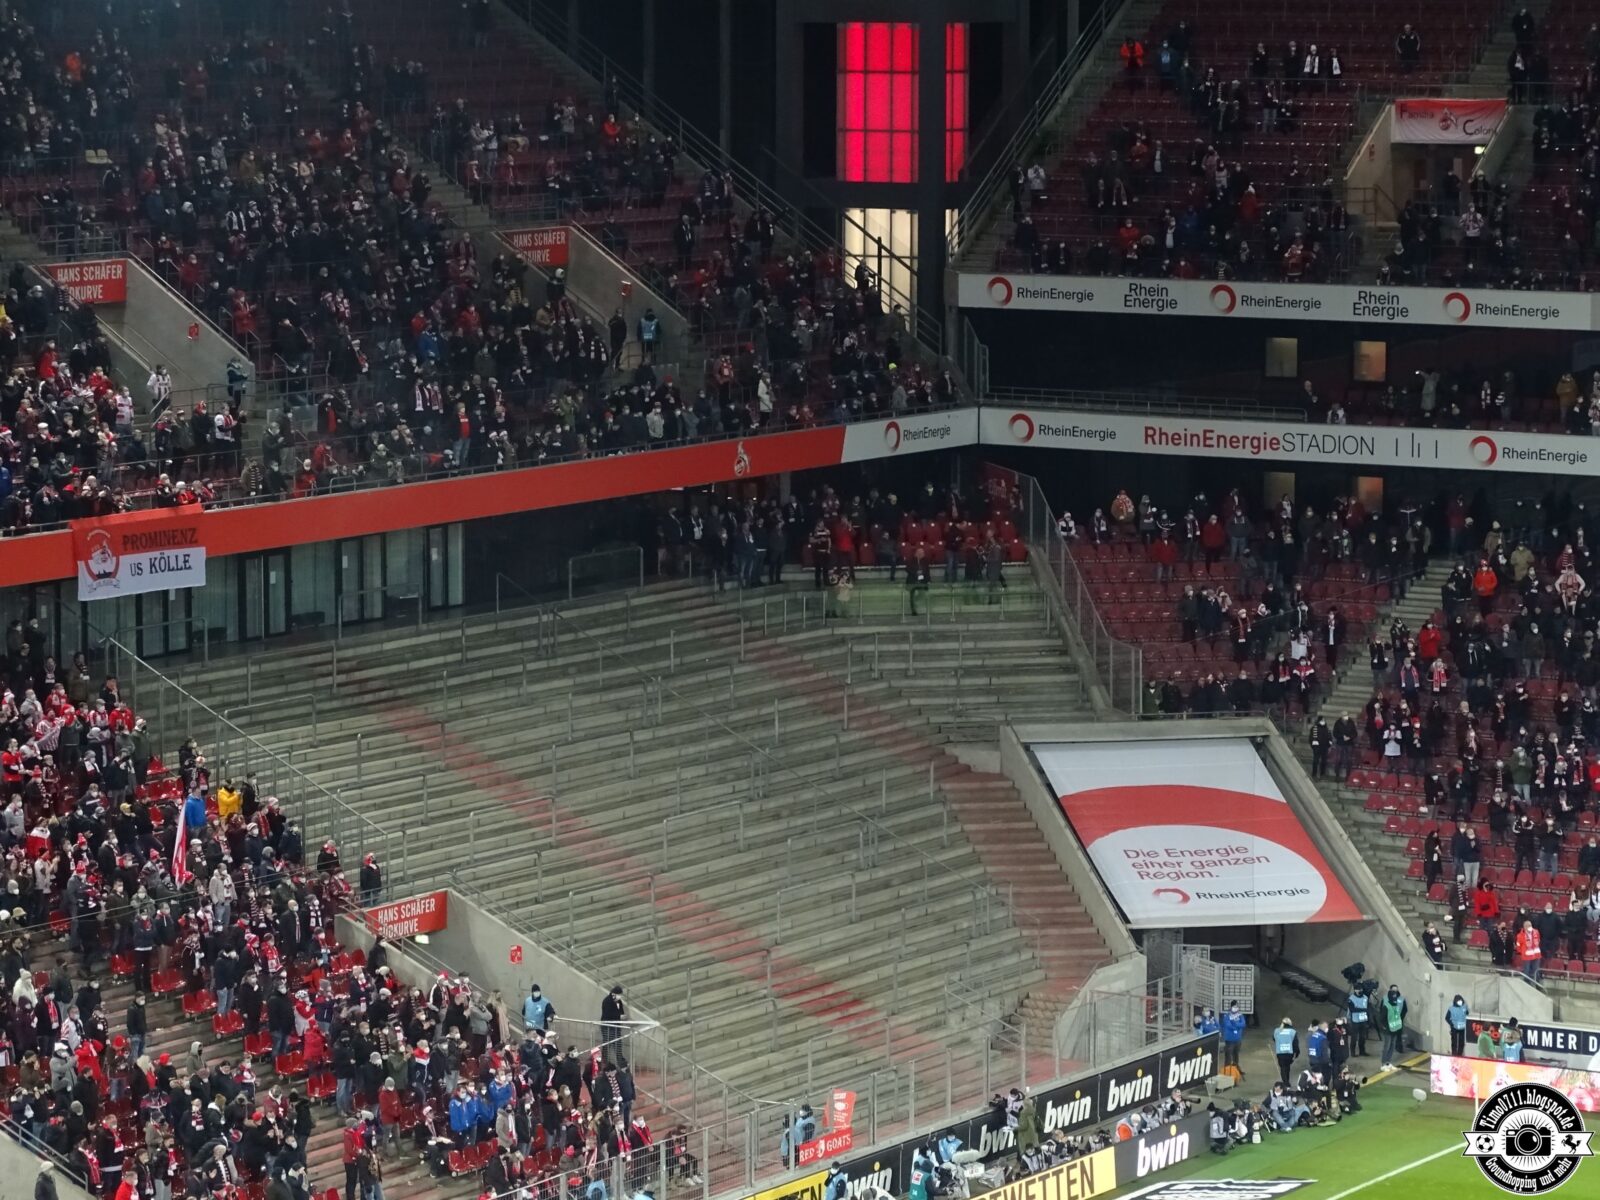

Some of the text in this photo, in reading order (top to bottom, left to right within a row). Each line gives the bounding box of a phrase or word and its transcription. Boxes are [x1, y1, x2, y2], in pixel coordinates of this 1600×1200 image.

[57, 262, 123, 283] HANS SCHÄFER
[1016, 286, 1094, 303] RheinEnergie
[1128, 282, 1169, 297] Rhein
[1358, 290, 1400, 305] Rhein
[1123, 295, 1178, 311] Energie
[1240, 294, 1322, 311] RheinEnergie
[1352, 303, 1409, 318] Energie
[1475, 302, 1560, 319] RheinEnergie
[903, 424, 951, 442] RheinEnergie
[1038, 423, 1117, 441] RheinEnergie
[1501, 446, 1588, 465] RheinEnergie
[121, 527, 199, 551] PROMINENZ
[149, 552, 192, 575] KÖLLE
[1123, 844, 1249, 860] Die Energie
[1131, 855, 1271, 871] einer ganzen
[1136, 868, 1220, 882] Region.
[1195, 887, 1310, 901] RheinEnergie
[378, 898, 436, 925] HANS SCHÄFER
[1521, 1028, 1578, 1051] MMER
[1168, 1047, 1212, 1089] bwin
[1107, 1068, 1153, 1112] bwin
[1044, 1090, 1092, 1134] bwin
[799, 1134, 851, 1162] RED GOATS
[979, 1123, 1018, 1157] bwi
[1137, 1124, 1189, 1178] bwin
